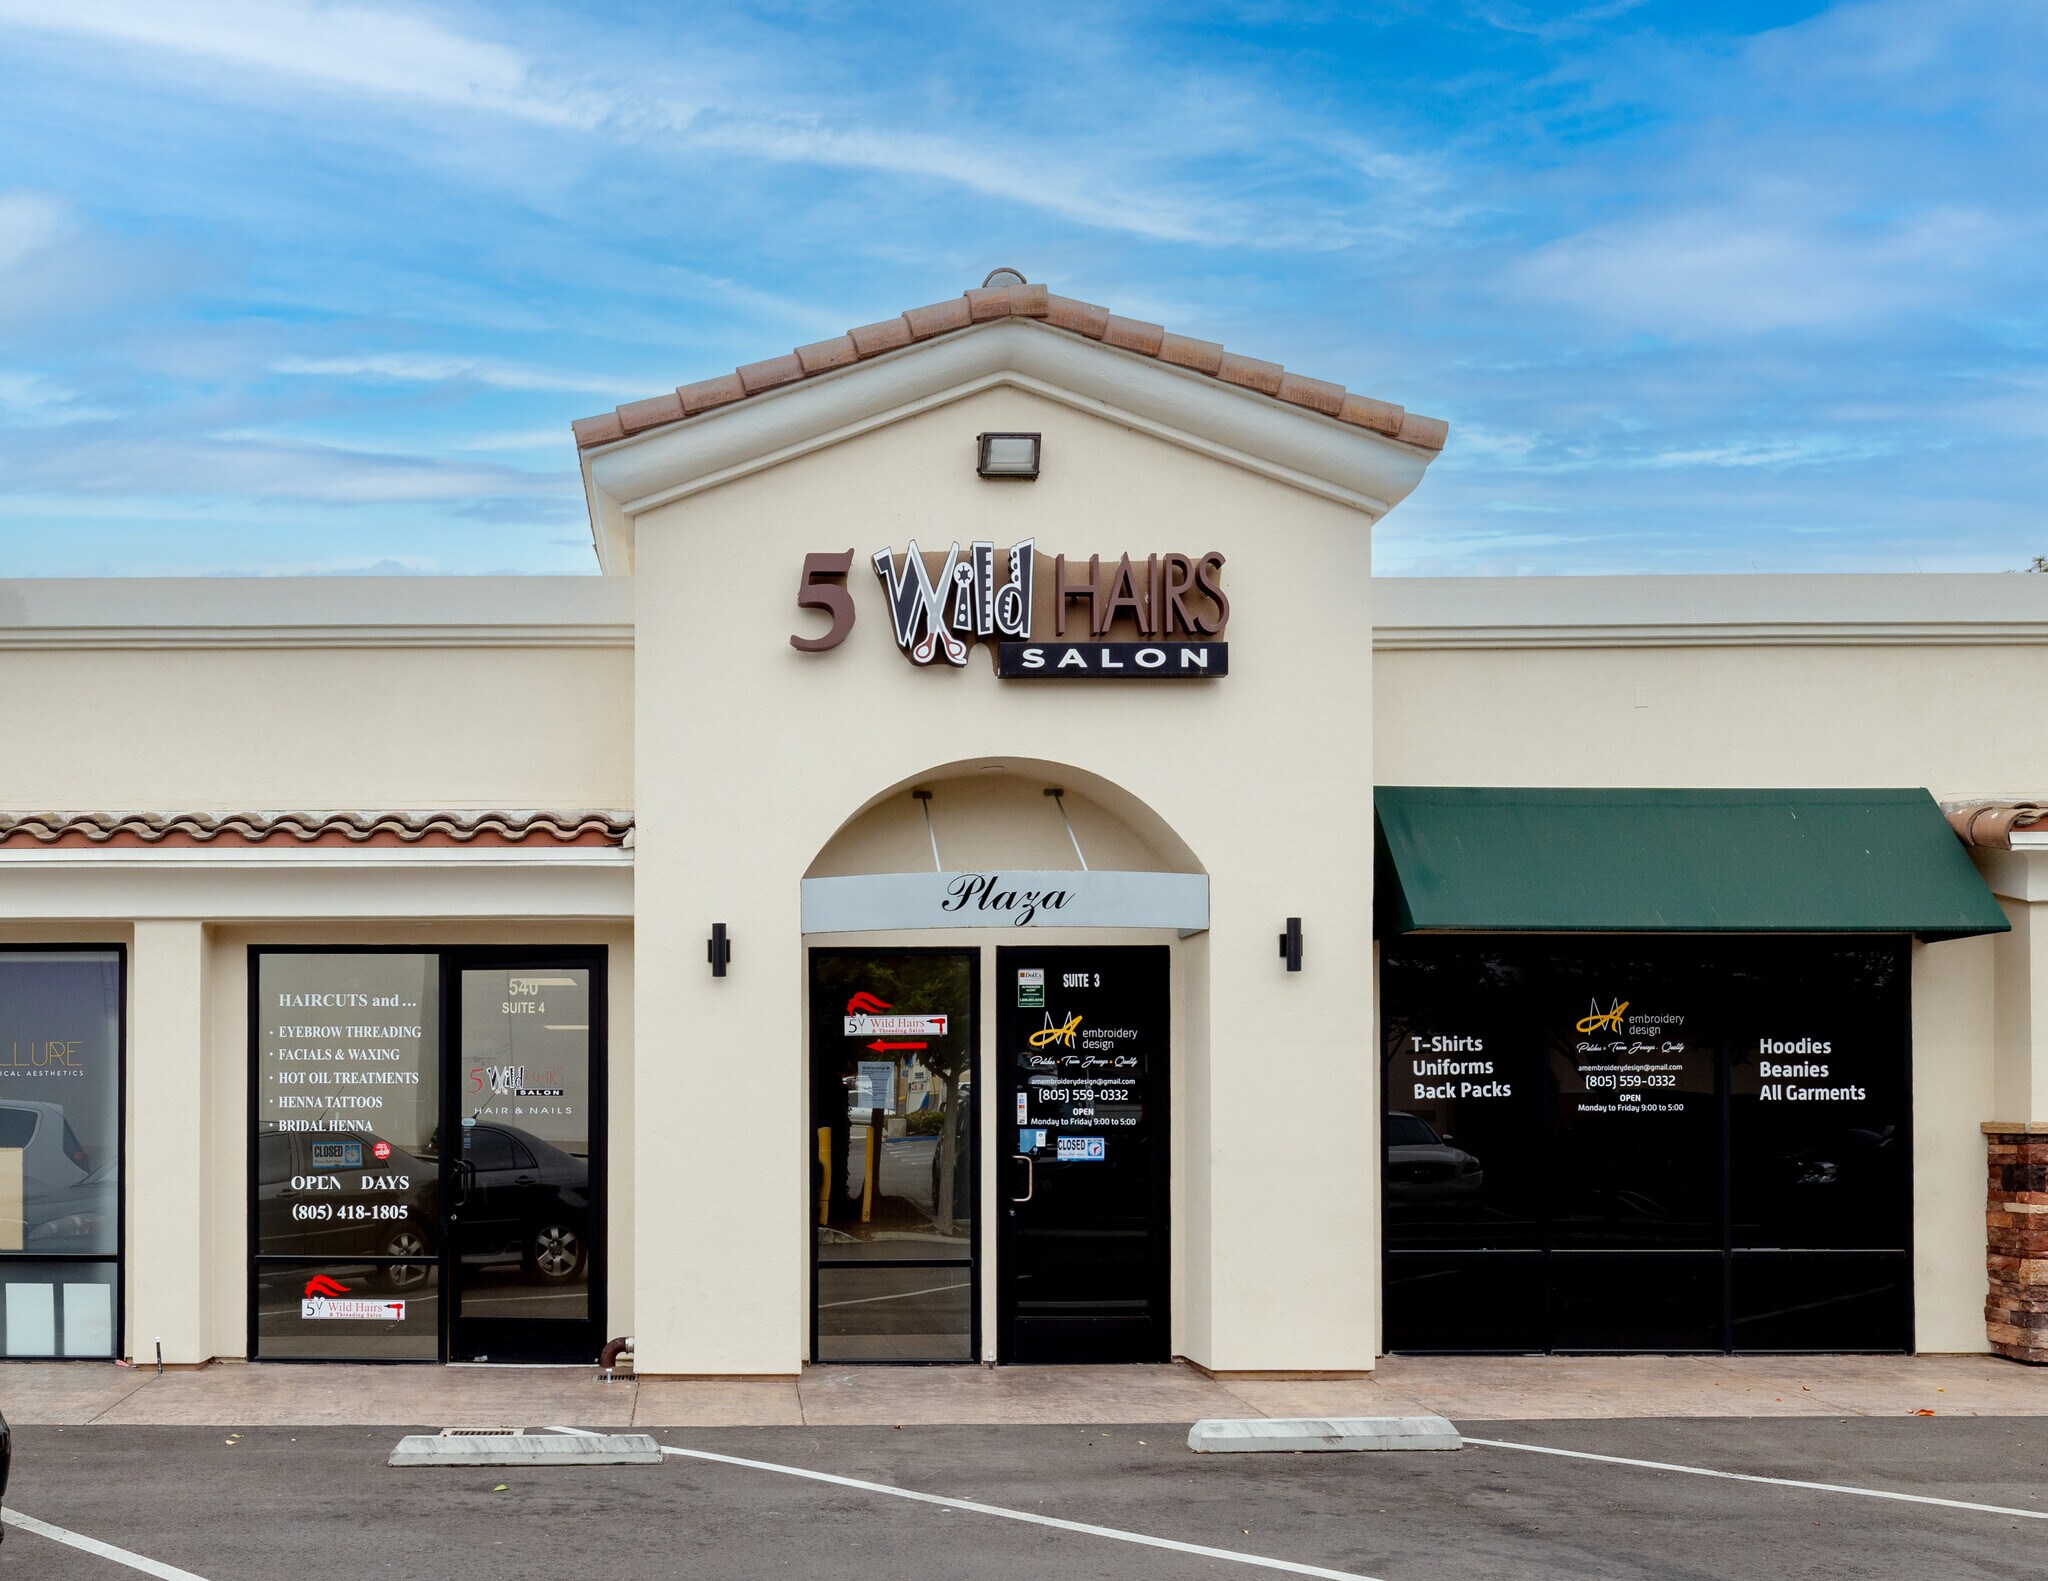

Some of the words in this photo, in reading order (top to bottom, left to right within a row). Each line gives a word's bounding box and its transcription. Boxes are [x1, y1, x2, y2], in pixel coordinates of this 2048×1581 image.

[790, 548, 855, 652] 5
[873, 537, 1035, 666] Wild
[1055, 551, 1230, 637] HAIRS
[1021, 648, 1208, 669] SALON
[942, 874, 1076, 927] Plaza
[508, 978, 539, 996] 540
[1063, 973, 1089, 988] SUITE
[1094, 973, 1100, 988] 3
[279, 993, 368, 1007] HAIRCUTS
[372, 993, 399, 1007] and
[502, 1002, 536, 1014] SUITE
[538, 1002, 546, 1014] 4
[870, 1018, 895, 1028] Wild
[898, 1018, 925, 1028] Hairs
[1629, 1014, 1684, 1025] embroidery
[279, 1026, 342, 1038] EYEBROW
[345, 1026, 422, 1038] THREADING
[1082, 1027, 1138, 1040] embroidery
[1629, 1025, 1661, 1036] design
[1082, 1039, 1114, 1051] design
[1411, 1035, 1483, 1052] T-Shirts
[1760, 1037, 1831, 1054] Hoodies
[278, 1048, 332, 1061] FACIALS
[335, 1048, 345, 1061] &
[347, 1048, 400, 1061] WAXING
[1413, 1058, 1493, 1076] Uniforms
[1578, 1063, 1683, 1072] amembroiderydesign@gmail.com
[1760, 1061, 1829, 1077] Beanies
[278, 1072, 306, 1084] HOT
[309, 1072, 331, 1084] OIL
[333, 1072, 419, 1084] TREATMENTS
[466, 1067, 484, 1094] 5
[1031, 1078, 1136, 1086] amembroiderydesign@gmail.com
[1586, 1075, 1616, 1089] (805)
[1620, 1075, 1676, 1087] 559-0332
[1039, 1088, 1069, 1103] (805)
[1072, 1089, 1129, 1101] 559-0332
[1414, 1082, 1456, 1099] Back
[1461, 1081, 1511, 1098] Packs
[1760, 1084, 1782, 1100] All
[1786, 1084, 1866, 1100] Garments
[278, 1096, 323, 1108] HENNA
[325, 1096, 383, 1108] TATTOOS
[1620, 1094, 1641, 1102] OPEN
[474, 1107, 509, 1115] HAIR
[515, 1107, 523, 1115] &
[529, 1107, 572, 1115] NAILS
[1072, 1108, 1094, 1116] OPEN
[1578, 1104, 1607, 1113] Monday
[1617, 1104, 1640, 1113] Friday
[278, 1119, 326, 1132] BRIDAL
[329, 1119, 373, 1132] HENNA
[1031, 1118, 1060, 1127] Monday
[1070, 1118, 1092, 1127] Friday
[1093, 1118, 1110, 1126] 9:00
[1111, 1118, 1119, 1126] to
[1120, 1118, 1136, 1126] 5:00
[314, 1145, 343, 1158] CLOSED
[1058, 1140, 1086, 1151] CLOSED
[290, 1175, 342, 1190] OPEN
[361, 1175, 410, 1190] DAYS
[292, 1203, 333, 1221] (805)
[336, 1204, 409, 1220] 418-1805
[328, 1302, 352, 1312] Wild
[356, 1302, 383, 1312] Hairs
